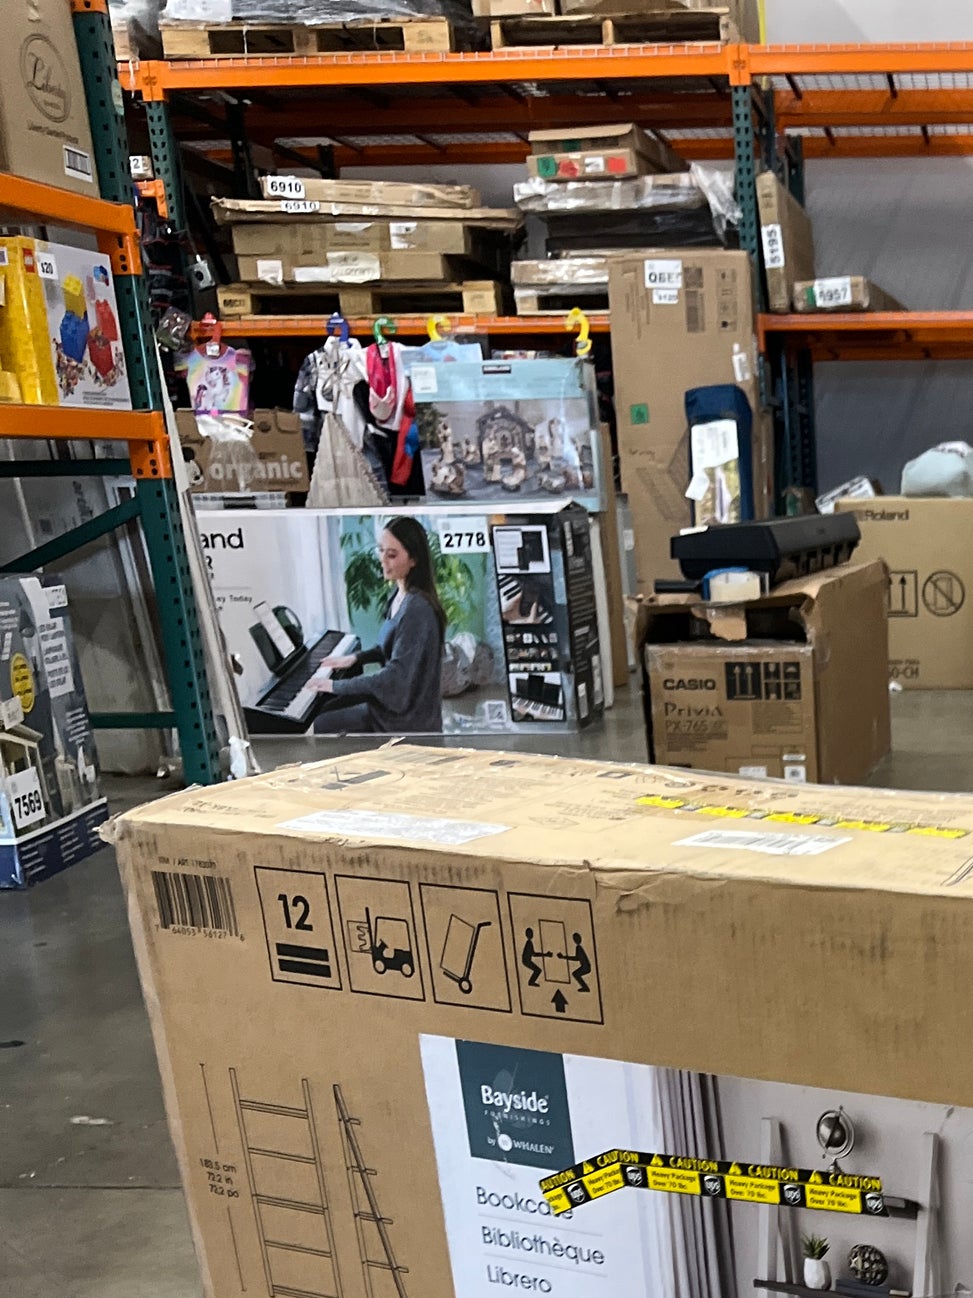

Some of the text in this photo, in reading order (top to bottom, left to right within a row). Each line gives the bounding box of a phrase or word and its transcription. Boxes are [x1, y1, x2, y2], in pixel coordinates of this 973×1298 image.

[270, 181, 302, 194] 6910
[865, 508, 910, 522] Roland
[443, 531, 487, 549] 2778
[663, 678, 717, 691] CASIO
[14, 789, 42, 820] 7569
[277, 893, 314, 932] 12
[481, 1084, 549, 1114] Bayside
[484, 1109, 551, 1126] FURNISHINGS
[486, 1136, 555, 1154] by WHALEN
[222, 1164, 237, 1173] cm
[597, 1151, 882, 1191] CAUTION CAUTION CAUTION CAUTION
[749, 1182, 776, 1192] Package
[830, 1190, 857, 1200] Package
[481, 1225, 605, 1265] Bibliothèque
[487, 1264, 553, 1293] Librero
